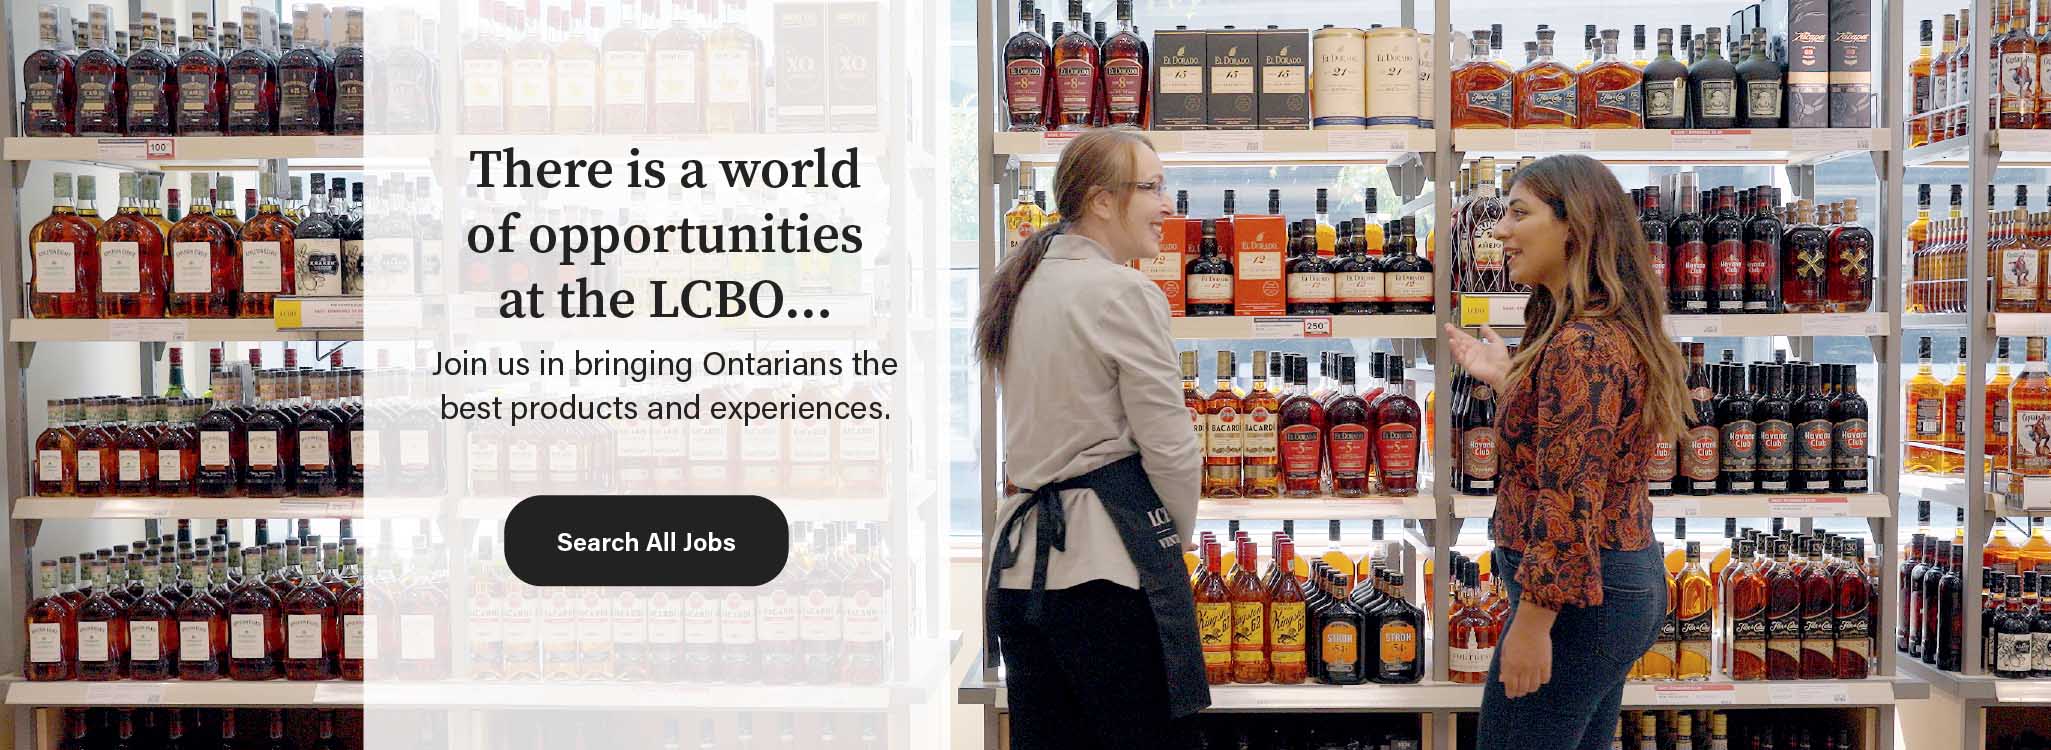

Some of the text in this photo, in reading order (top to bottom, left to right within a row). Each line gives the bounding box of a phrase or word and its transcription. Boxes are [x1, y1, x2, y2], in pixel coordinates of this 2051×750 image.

[1172, 55, 1199, 65] DORADO
[1224, 56, 1250, 65] DORADO
[1276, 56, 1302, 65] DORADO
[1174, 70, 1187, 79] 15
[1225, 70, 1239, 79] 15
[1276, 70, 1290, 79] 15
[1332, 67, 1347, 77] 21
[1387, 67, 1402, 77] 21
[1419, 72, 1431, 81] 21
[1020, 77, 1029, 89] 8
[1070, 77, 1078, 89] 8
[1118, 77, 1127, 89] 8
[151, 143, 166, 151] 100
[1152, 255, 1166, 264] 12
[1252, 255, 1266, 264] 12
[1306, 322, 1324, 330] 250
[1729, 432, 1755, 440] Havana
[1760, 431, 1788, 440] Havana
[1804, 431, 1831, 439] Havana
[1470, 440, 1495, 449] Havana
[1691, 441, 1717, 449] Havana
[1735, 439, 1751, 448] Club
[1765, 439, 1782, 447] Club
[1810, 438, 1827, 447] Club
[1848, 437, 1864, 446] Club
[1298, 443, 1304, 454] 5
[1345, 442, 1352, 453] 5
[1394, 442, 1400, 452] 5
[1474, 447, 1490, 456] Club
[1697, 448, 1713, 456] Club
[1844, 543, 1857, 552] 130
[1251, 615, 1261, 632] 62
[1386, 633, 1411, 642] STROH
